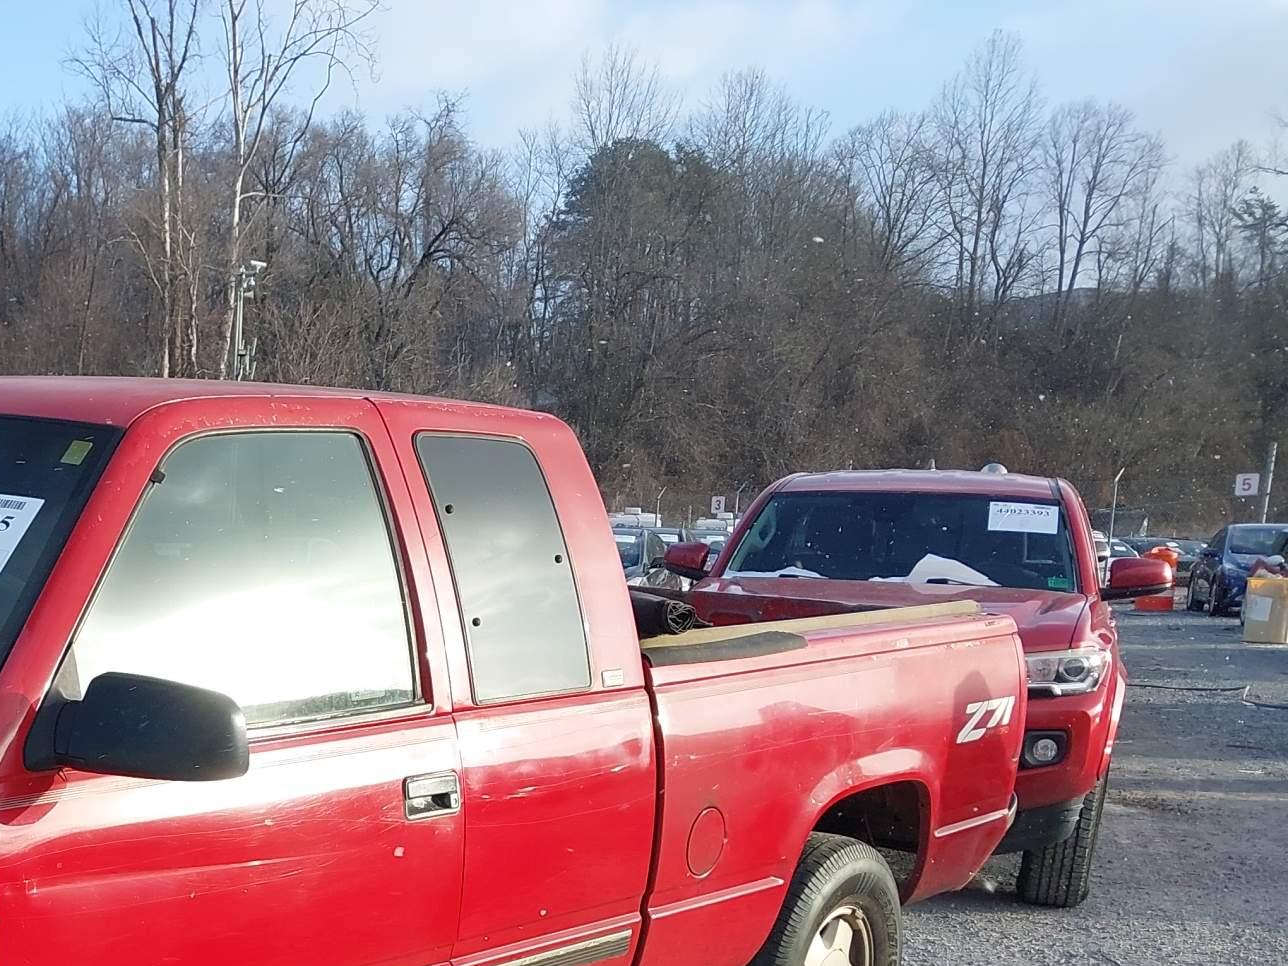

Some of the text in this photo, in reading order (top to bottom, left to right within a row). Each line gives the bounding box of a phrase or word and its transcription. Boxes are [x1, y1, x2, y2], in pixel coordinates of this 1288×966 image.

[1242, 478, 1252, 491] 5
[714, 499, 722, 511] 3
[956, 695, 1016, 744] Z71
